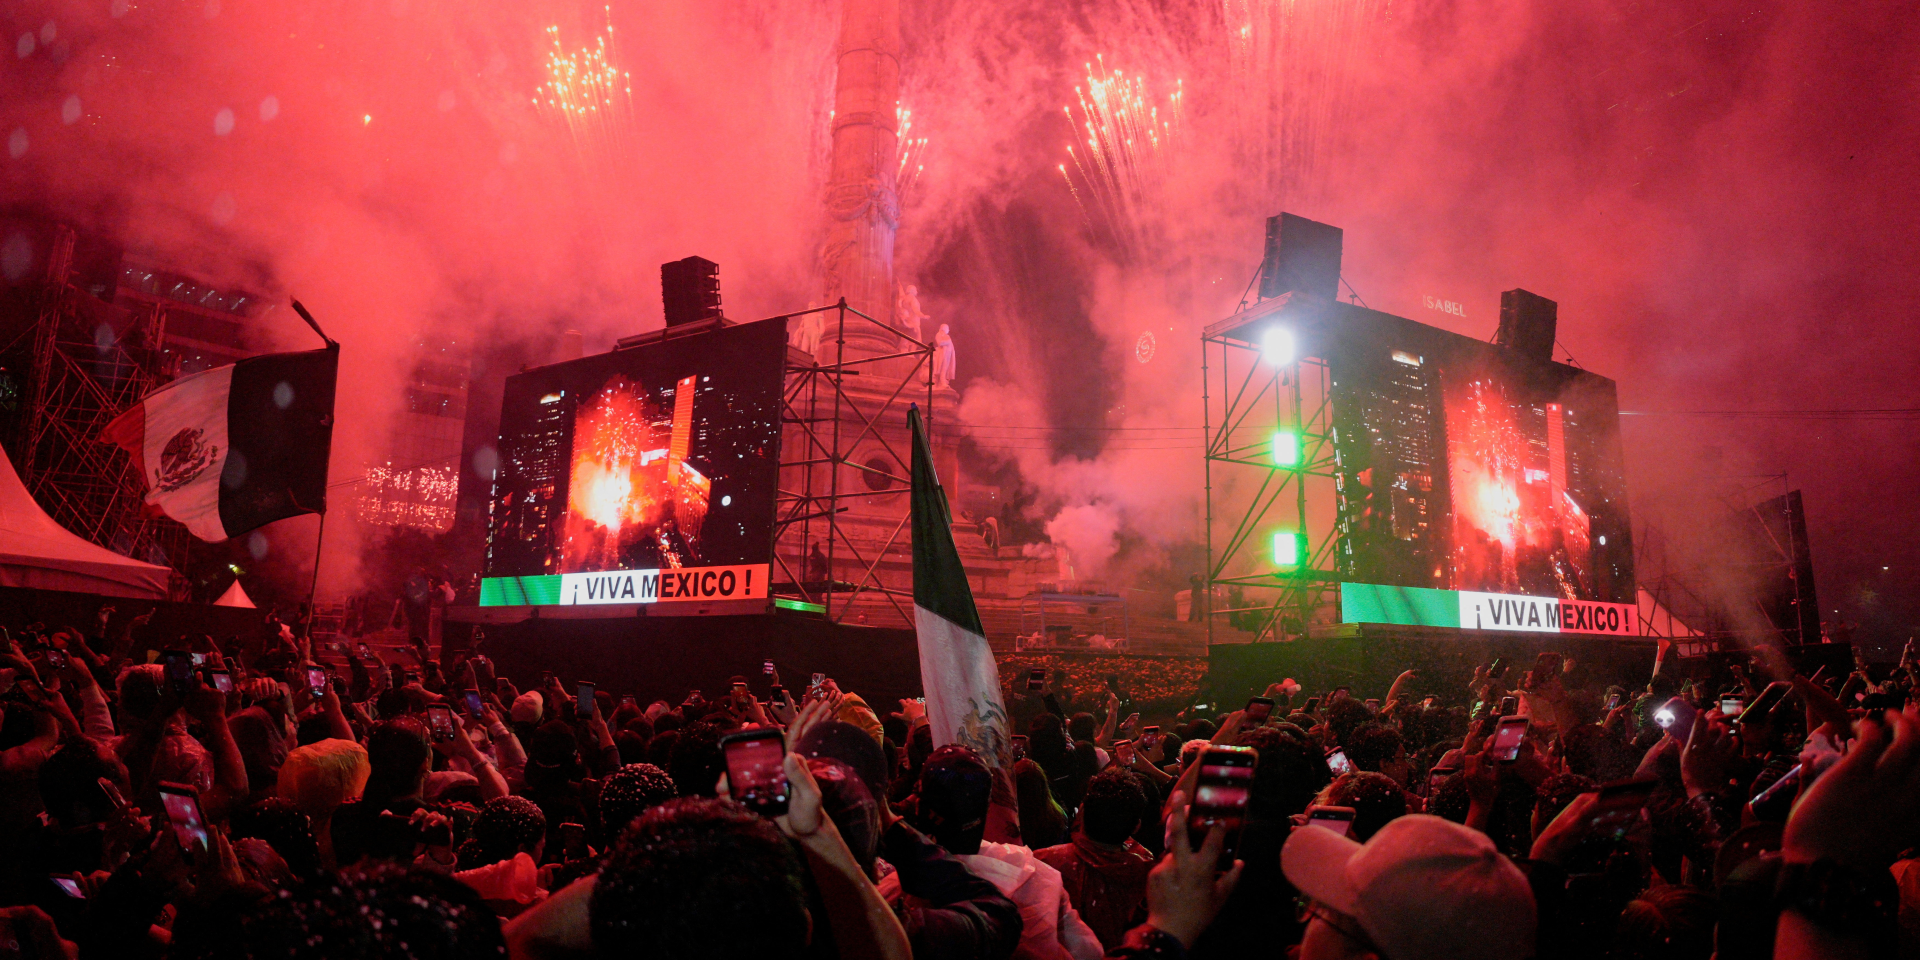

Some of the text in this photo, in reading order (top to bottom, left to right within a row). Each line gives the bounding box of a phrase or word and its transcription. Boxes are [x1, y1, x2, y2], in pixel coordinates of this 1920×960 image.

[1422, 295, 1467, 317] ISABEL
[586, 574, 636, 600] VIVA
[641, 570, 737, 599] MEXICO
[1488, 598, 1542, 628] VIVA
[1546, 603, 1620, 632] MEXICO
